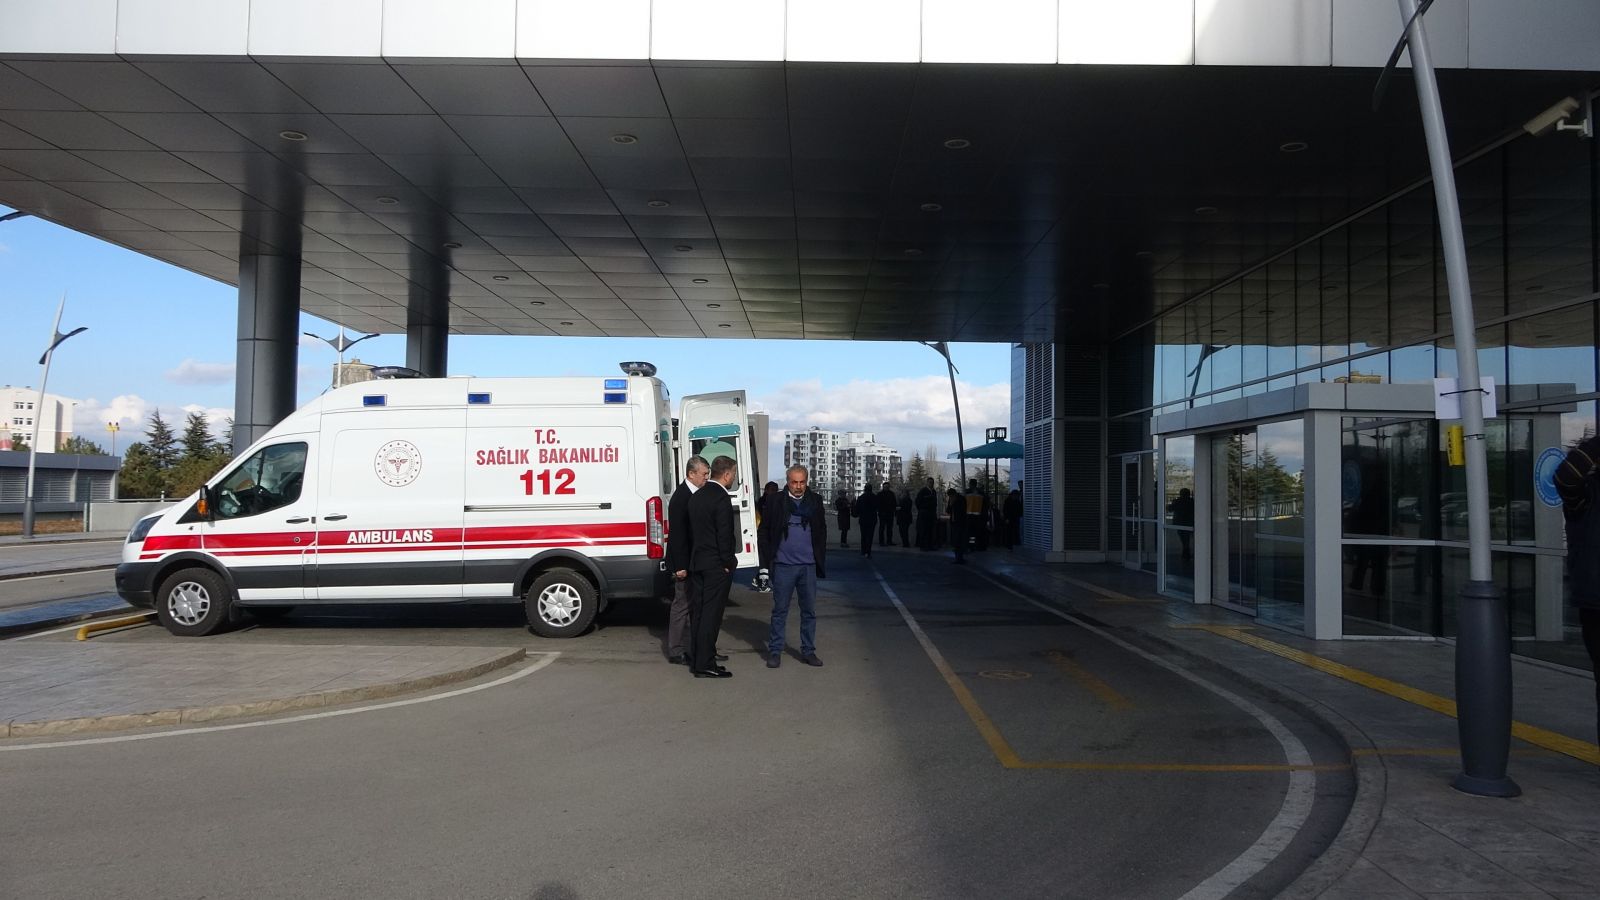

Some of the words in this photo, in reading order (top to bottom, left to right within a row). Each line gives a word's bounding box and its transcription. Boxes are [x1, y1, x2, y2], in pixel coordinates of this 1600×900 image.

[534, 428, 560, 445] T.C.
[476, 445, 530, 466] SAĞLIK
[538, 444, 619, 464] BAKANLIĞI
[519, 467, 576, 496] 112
[346, 529, 434, 544] AMBULANS
